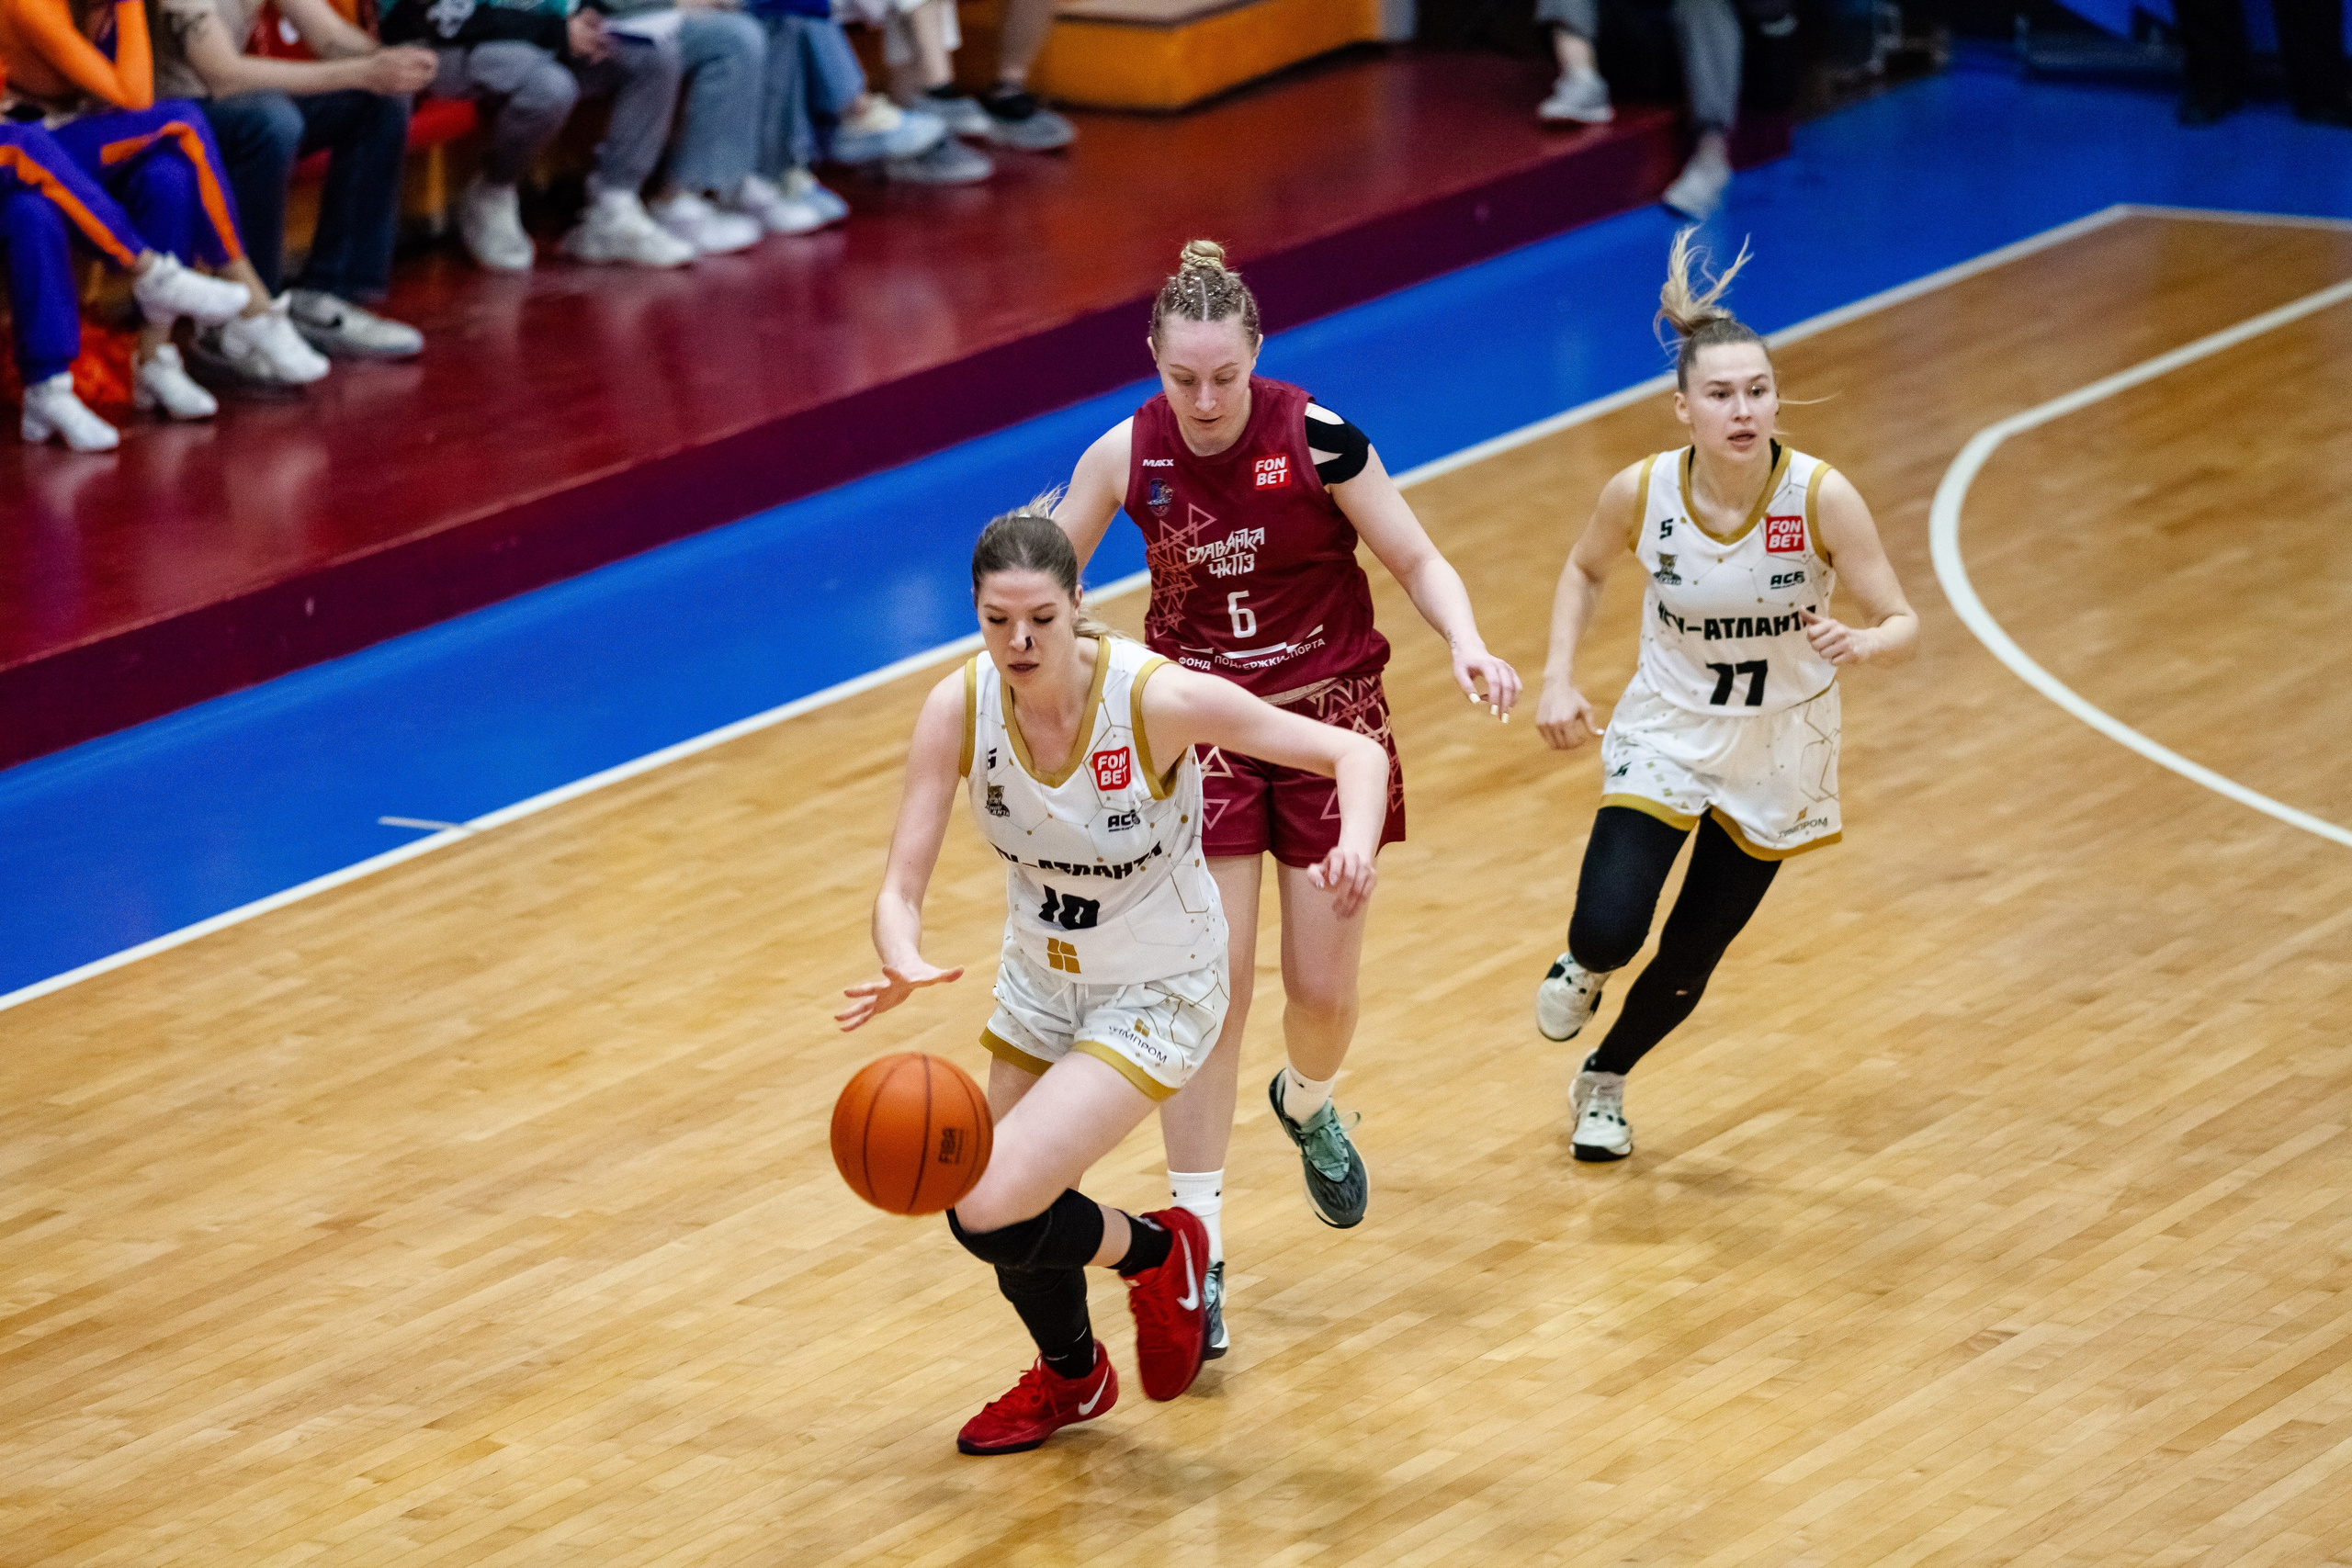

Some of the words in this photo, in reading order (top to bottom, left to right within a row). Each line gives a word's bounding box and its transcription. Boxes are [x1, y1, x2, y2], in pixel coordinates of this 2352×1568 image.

[1142, 458, 1174, 467] MAXX
[1255, 457, 1286, 472] FON
[1256, 468, 1288, 486] BET
[1769, 520, 1802, 534] FON
[1769, 534, 1803, 548] BET
[1227, 591, 1257, 638] 6
[1178, 656, 1212, 671] ФОНД
[1706, 659, 1769, 707] 77
[1098, 750, 1127, 771] FON
[1101, 765, 1128, 786] BET
[1038, 884, 1101, 931] 10
